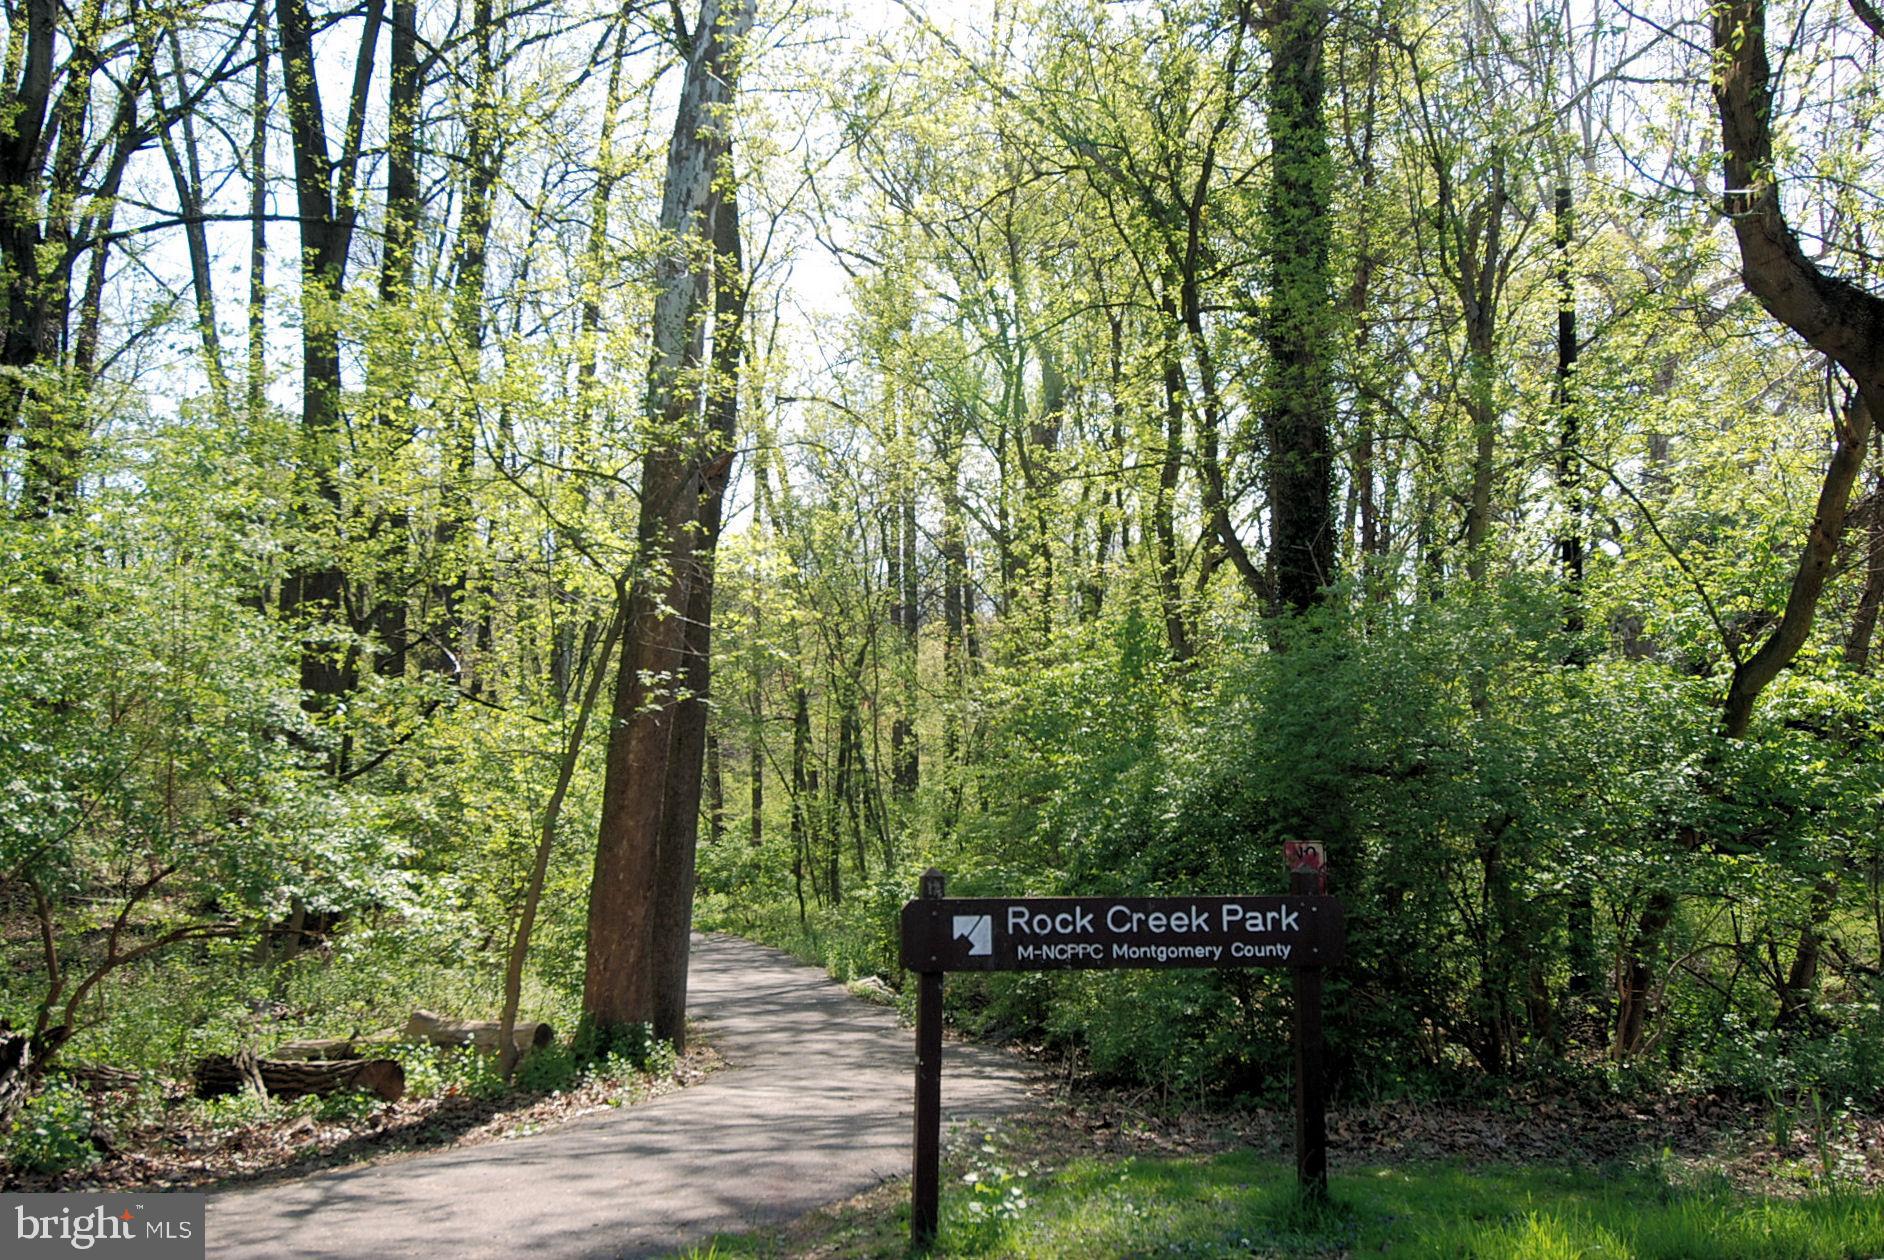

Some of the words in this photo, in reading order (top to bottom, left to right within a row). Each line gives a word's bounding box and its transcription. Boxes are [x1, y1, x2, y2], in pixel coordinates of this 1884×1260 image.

[1007, 905, 1094, 934] Rock
[1106, 904, 1209, 933] Creek
[1222, 904, 1299, 932] Park
[1017, 944, 1104, 960] M-NCPPC
[1112, 943, 1222, 961] Montgomery
[1231, 942, 1291, 960] County
